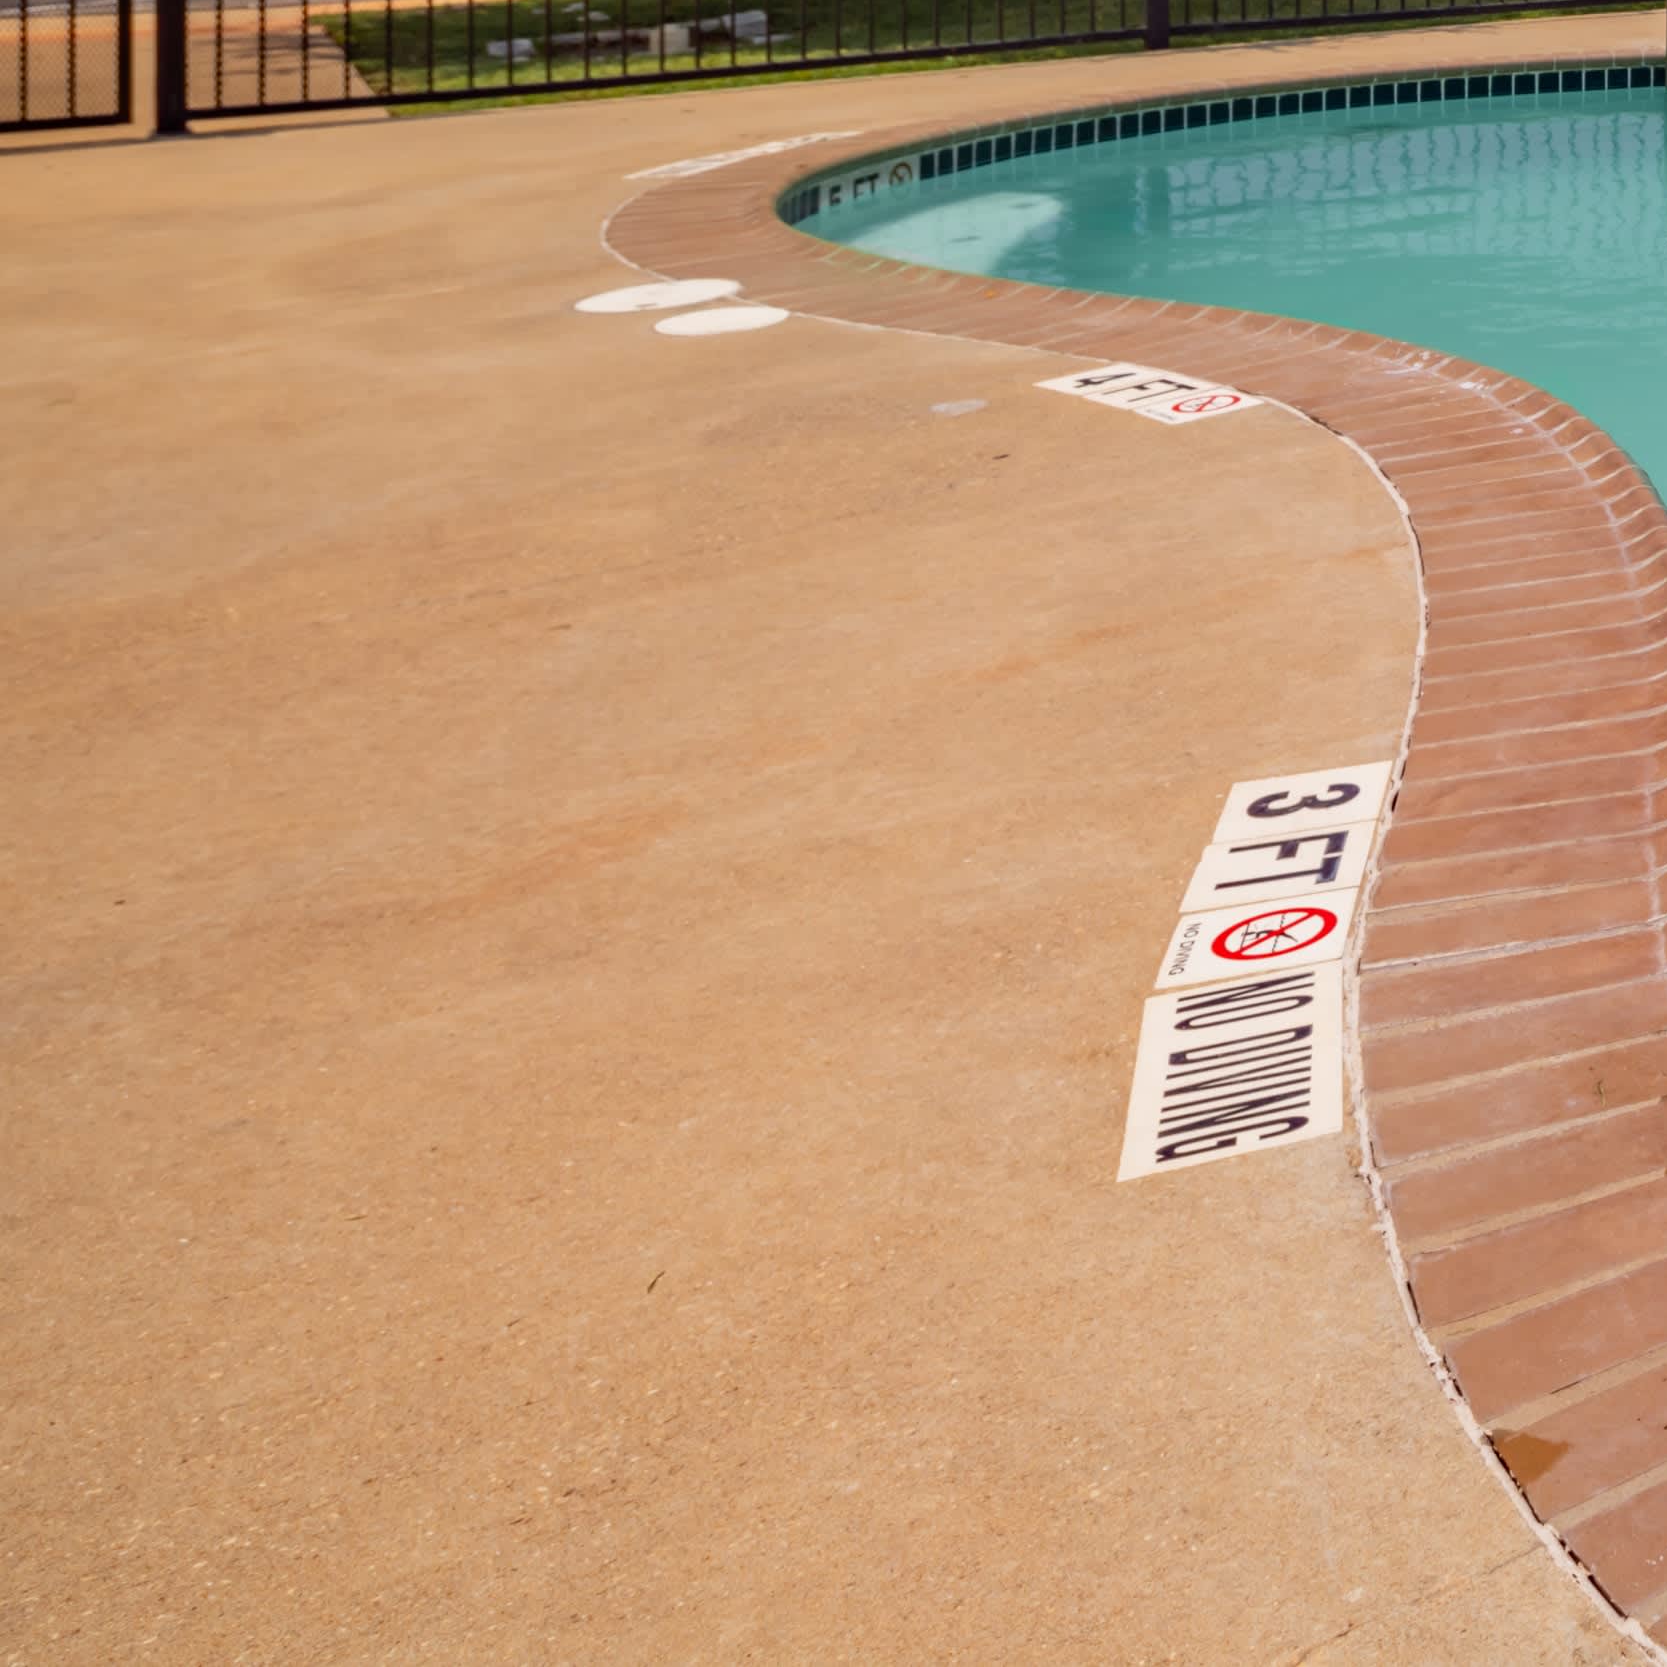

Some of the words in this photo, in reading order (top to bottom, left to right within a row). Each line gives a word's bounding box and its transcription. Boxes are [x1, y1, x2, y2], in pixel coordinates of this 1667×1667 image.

[1246, 782, 1361, 818] 3
[1214, 830, 1350, 891] FT
[1183, 922, 1202, 939] NO
[1168, 940, 1196, 976] DIVING
[1174, 971, 1315, 1031] NO
[1155, 1023, 1313, 1164] DIVING
